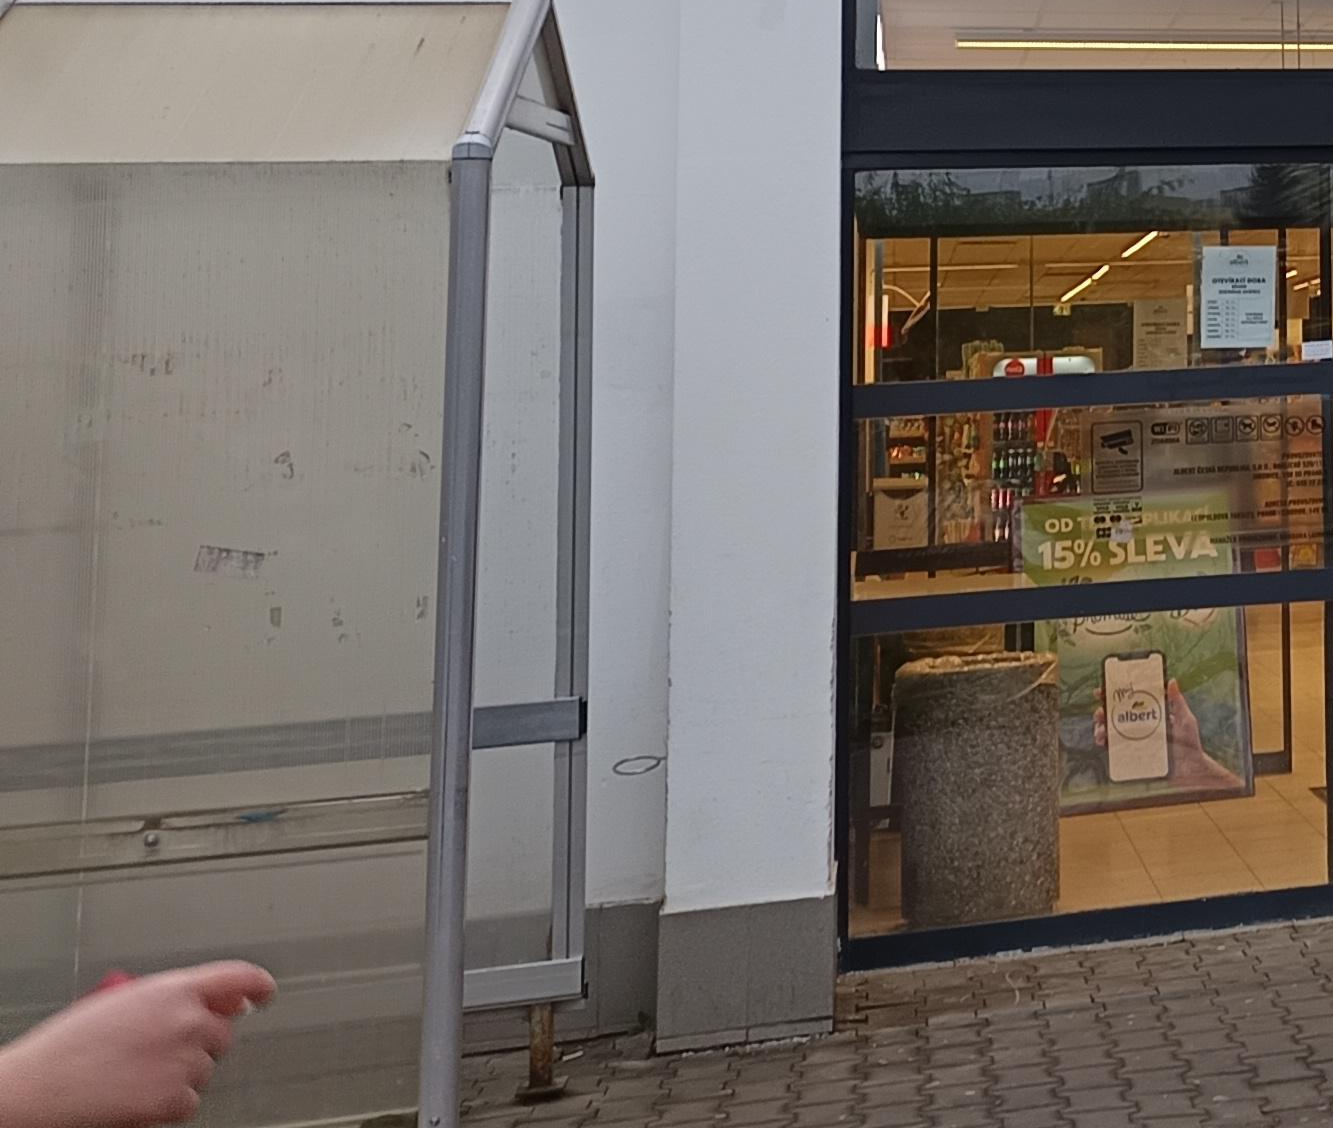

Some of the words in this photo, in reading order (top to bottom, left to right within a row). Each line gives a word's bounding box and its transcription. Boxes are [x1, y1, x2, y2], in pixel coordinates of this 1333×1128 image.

[1045, 518, 1073, 534] OD
[1038, 537, 1101, 570] 15%
[1109, 531, 1218, 565] SLEVA
[1118, 708, 1158, 723] albert
